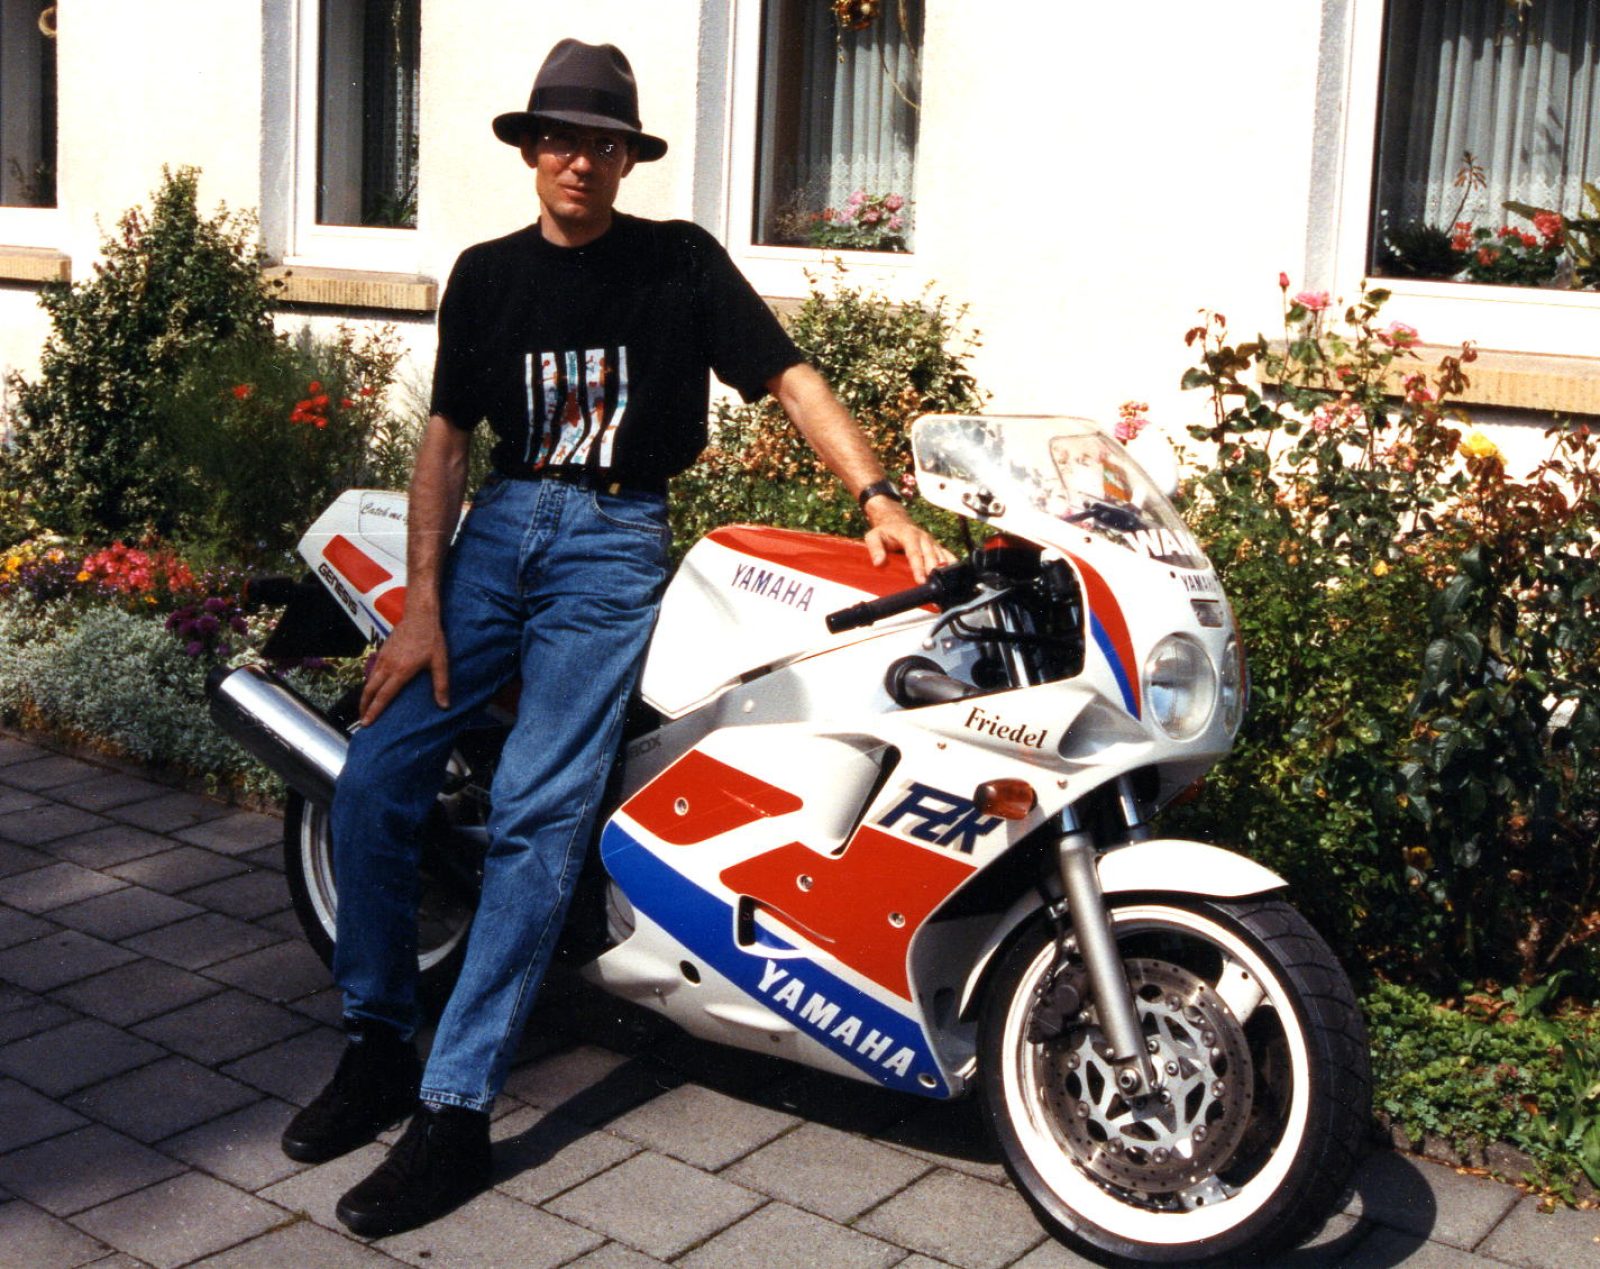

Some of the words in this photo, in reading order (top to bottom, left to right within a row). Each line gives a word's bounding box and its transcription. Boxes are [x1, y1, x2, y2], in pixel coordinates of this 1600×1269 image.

[318, 562, 358, 616] GENESIS
[731, 562, 816, 612] YAMAHA
[964, 706, 1049, 750] Friedel
[757, 958, 916, 1078] YAMAHA
